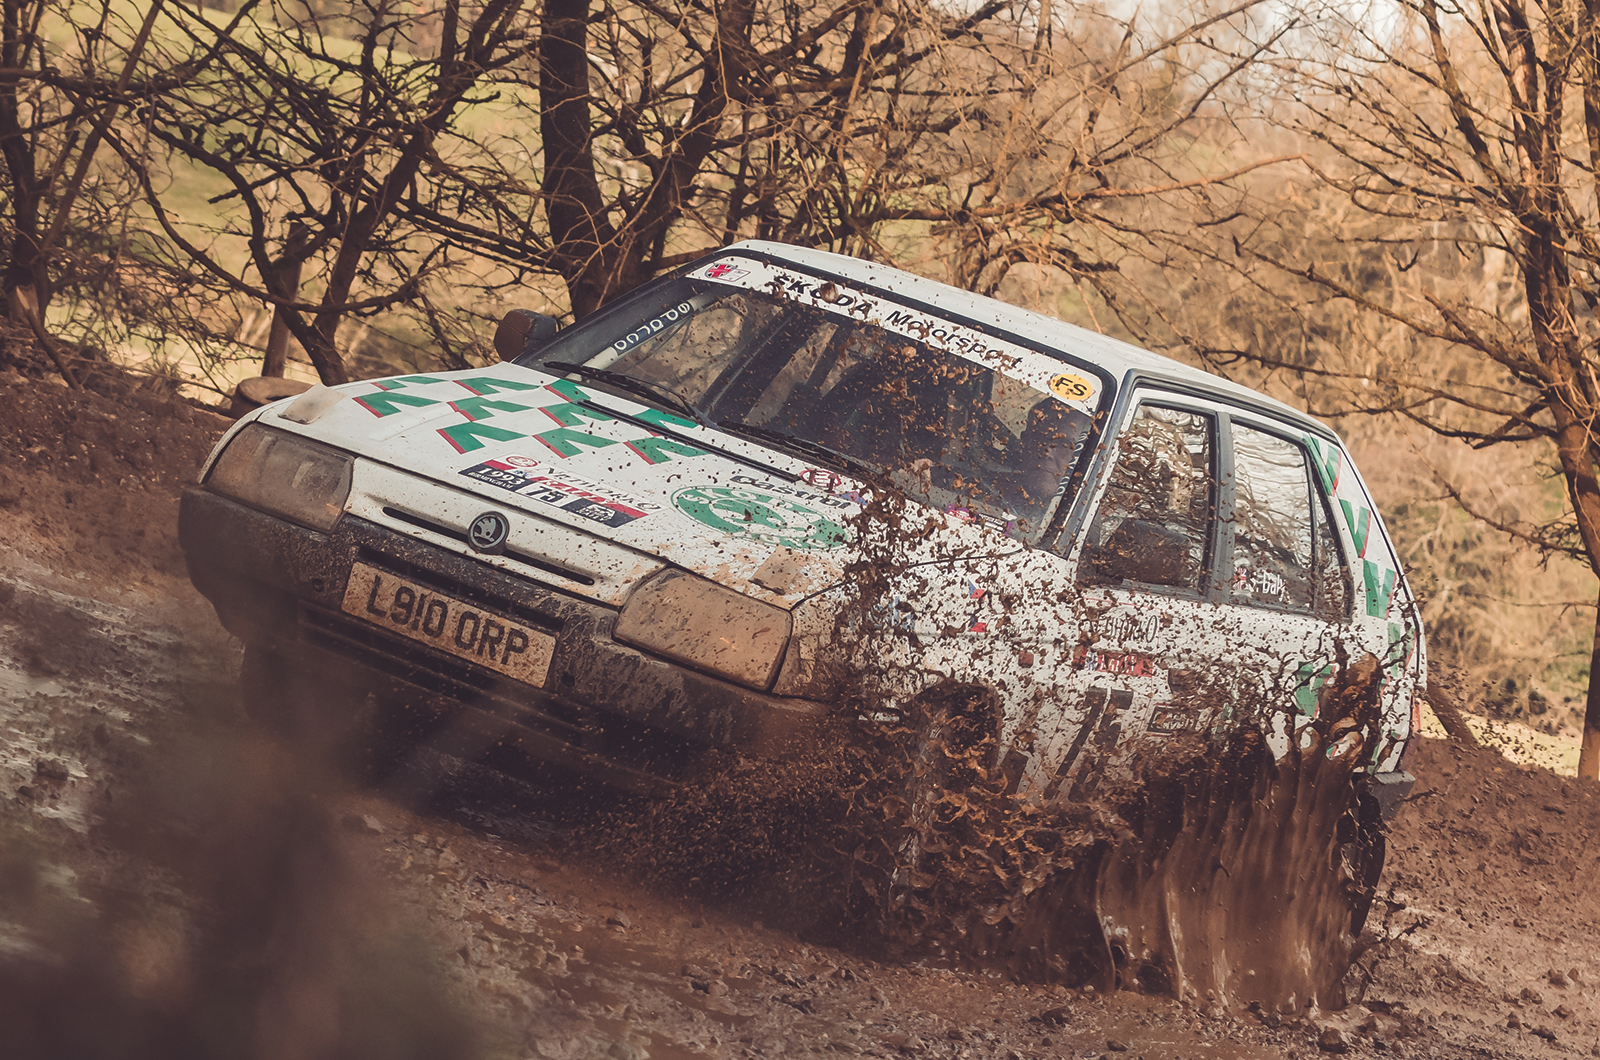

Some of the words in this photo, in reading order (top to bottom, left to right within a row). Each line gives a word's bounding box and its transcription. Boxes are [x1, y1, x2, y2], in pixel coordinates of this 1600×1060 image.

[1054, 376, 1088, 397] FS
[477, 467, 526, 486] 1993
[526, 485, 569, 503] 75
[730, 475, 852, 510] Castrol
[365, 574, 449, 639] L910
[454, 610, 529, 666] ORP
